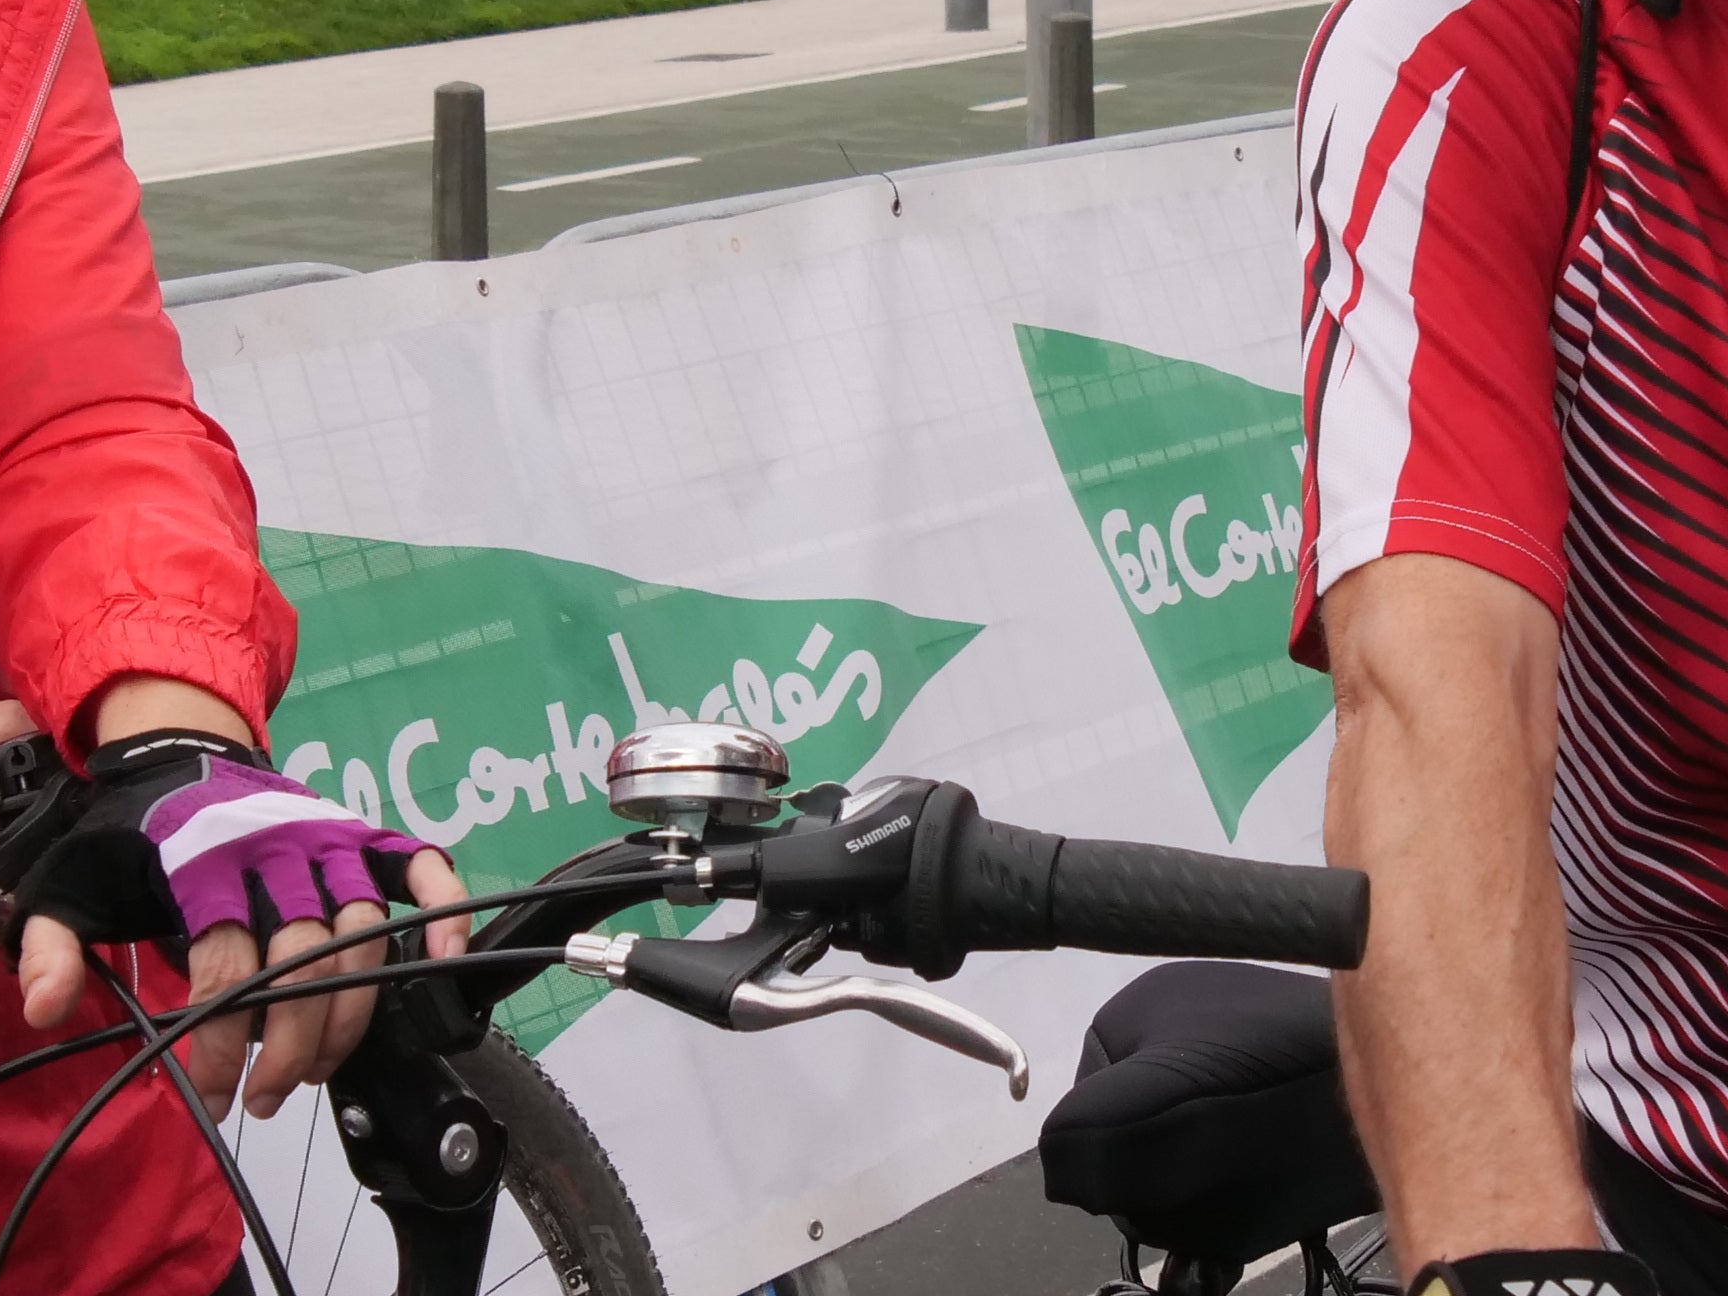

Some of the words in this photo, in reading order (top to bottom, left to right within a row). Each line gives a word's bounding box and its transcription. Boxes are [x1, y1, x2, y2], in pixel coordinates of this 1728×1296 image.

[1101, 508, 1183, 615] El
[387, 700, 617, 848] Corte
[844, 813, 913, 855] SHIMANO
